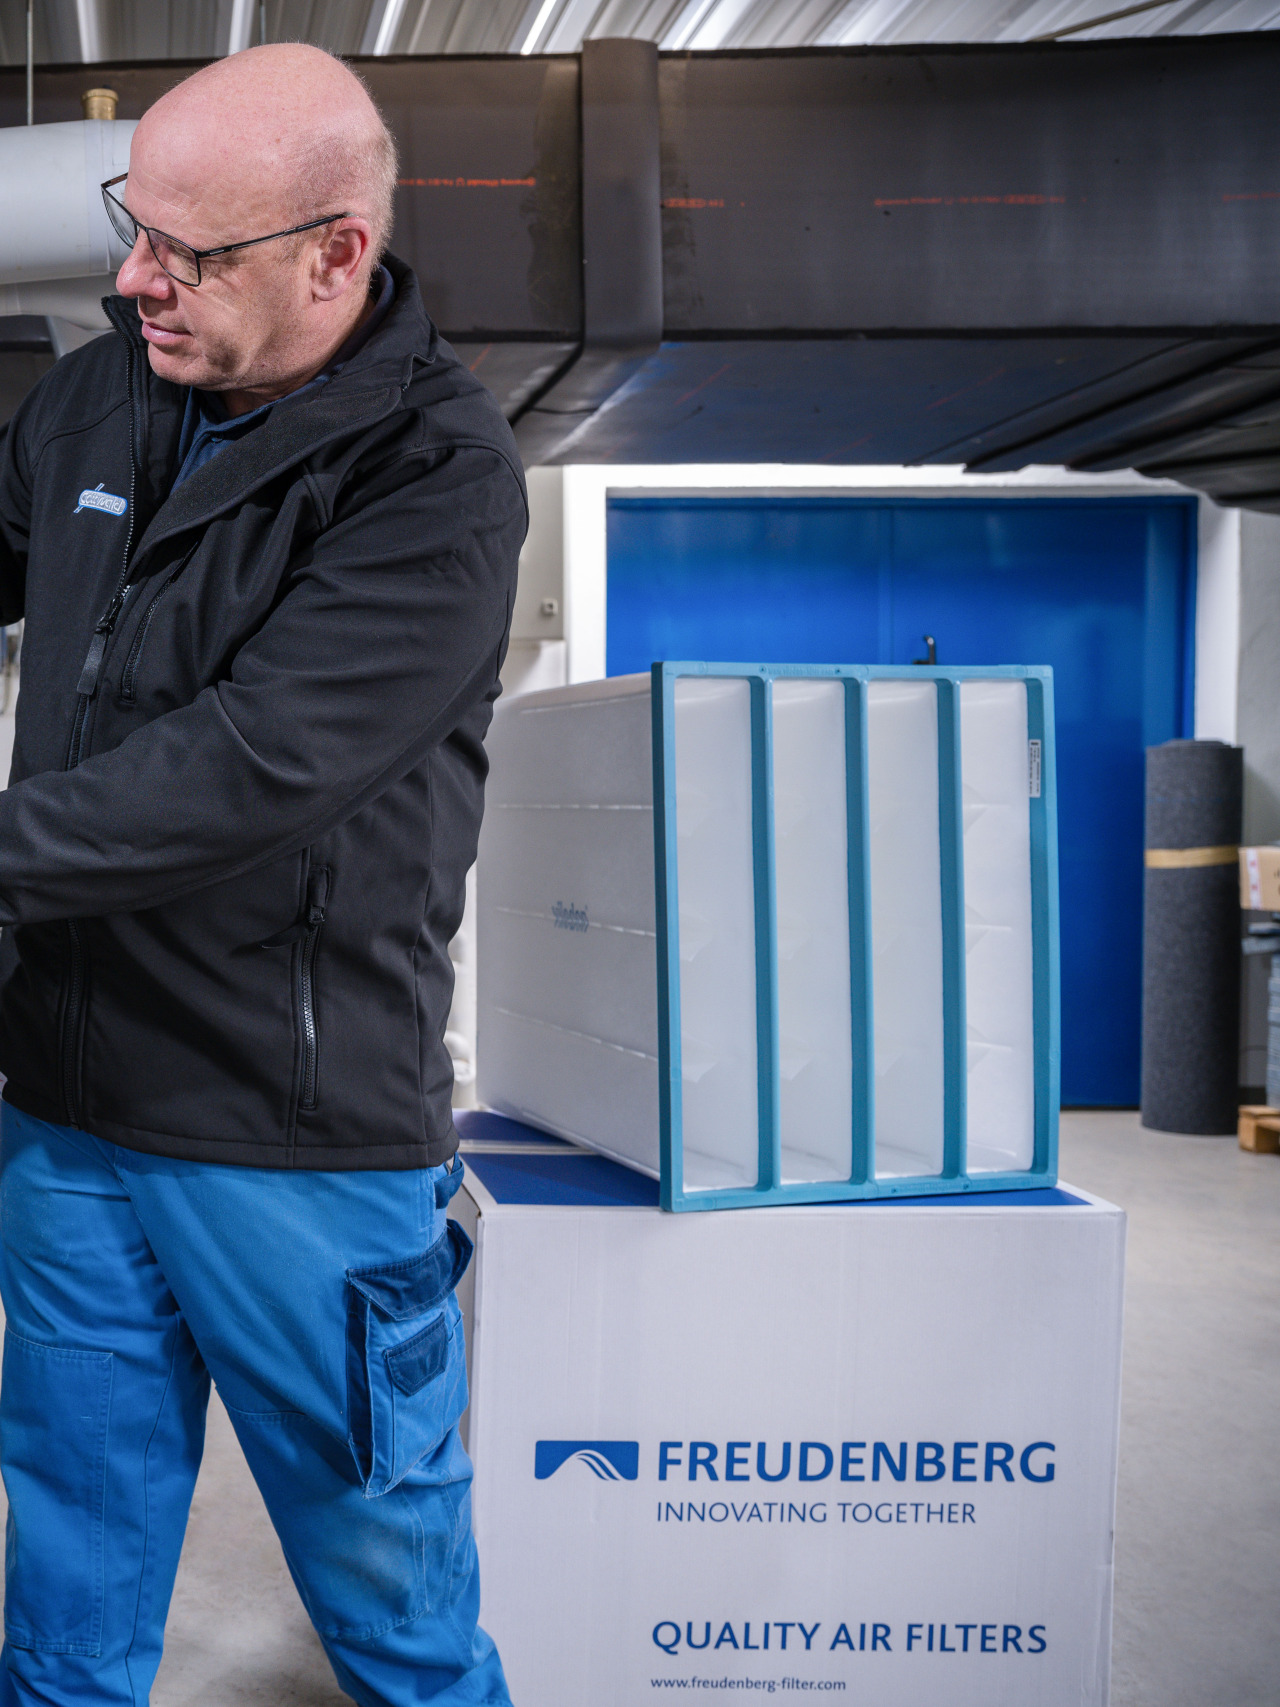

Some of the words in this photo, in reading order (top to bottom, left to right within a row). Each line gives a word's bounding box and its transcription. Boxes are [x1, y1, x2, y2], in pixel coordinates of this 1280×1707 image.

[658, 1441, 1056, 1483] FREUDENBERG
[657, 1502, 828, 1523] INNOVATING
[837, 1503, 976, 1523] TOGETHER
[652, 1621, 821, 1655] QUALITY
[830, 1622, 892, 1651] AIR
[906, 1624, 1048, 1654] FILTERS
[651, 1677, 846, 1693] www.freudenberg-filter.com
